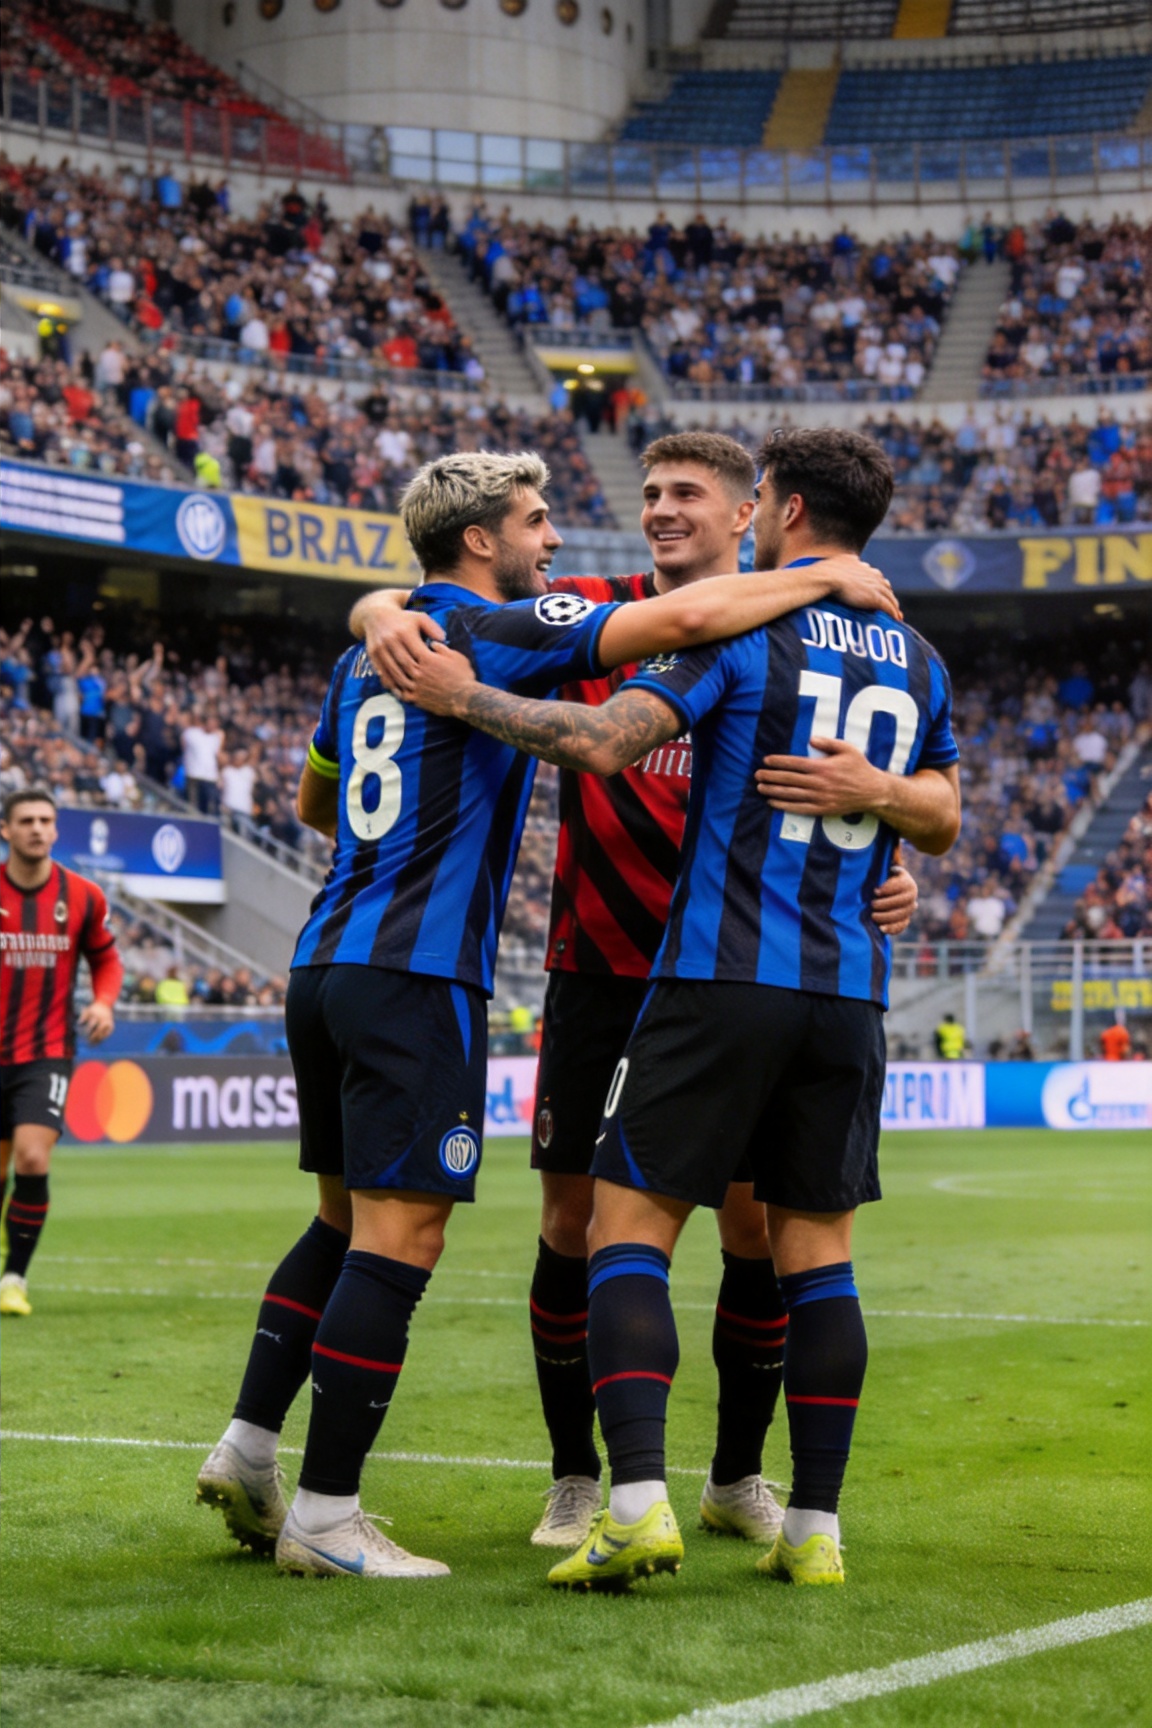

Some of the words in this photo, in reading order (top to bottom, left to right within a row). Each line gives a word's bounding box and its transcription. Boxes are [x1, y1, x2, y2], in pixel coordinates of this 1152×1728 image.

[265, 507, 397, 570] BRAZ
[347, 692, 405, 841] 8
[604, 1057, 629, 1118] 0
